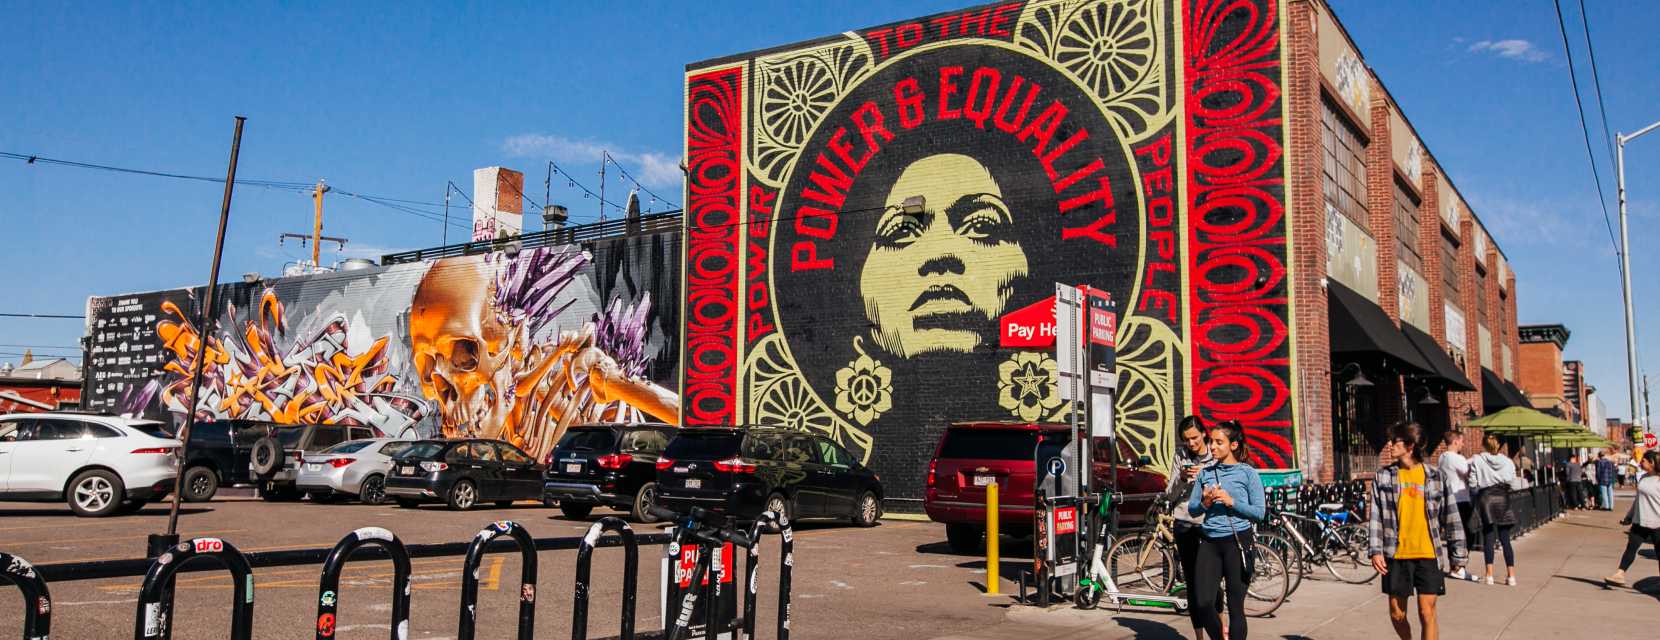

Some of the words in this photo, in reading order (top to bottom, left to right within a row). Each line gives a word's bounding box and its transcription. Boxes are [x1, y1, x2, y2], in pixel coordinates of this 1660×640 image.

[866, 22, 924, 59] TO
[930, 2, 1025, 39] THE
[791, 101, 896, 273] POWER
[893, 77, 926, 129] &
[938, 66, 1117, 249] EQUALITY
[1135, 132, 1177, 325] PEOPLE
[748, 185, 777, 342] POWER
[1008, 323, 1035, 340] Pay
[1040, 322, 1057, 337] He
